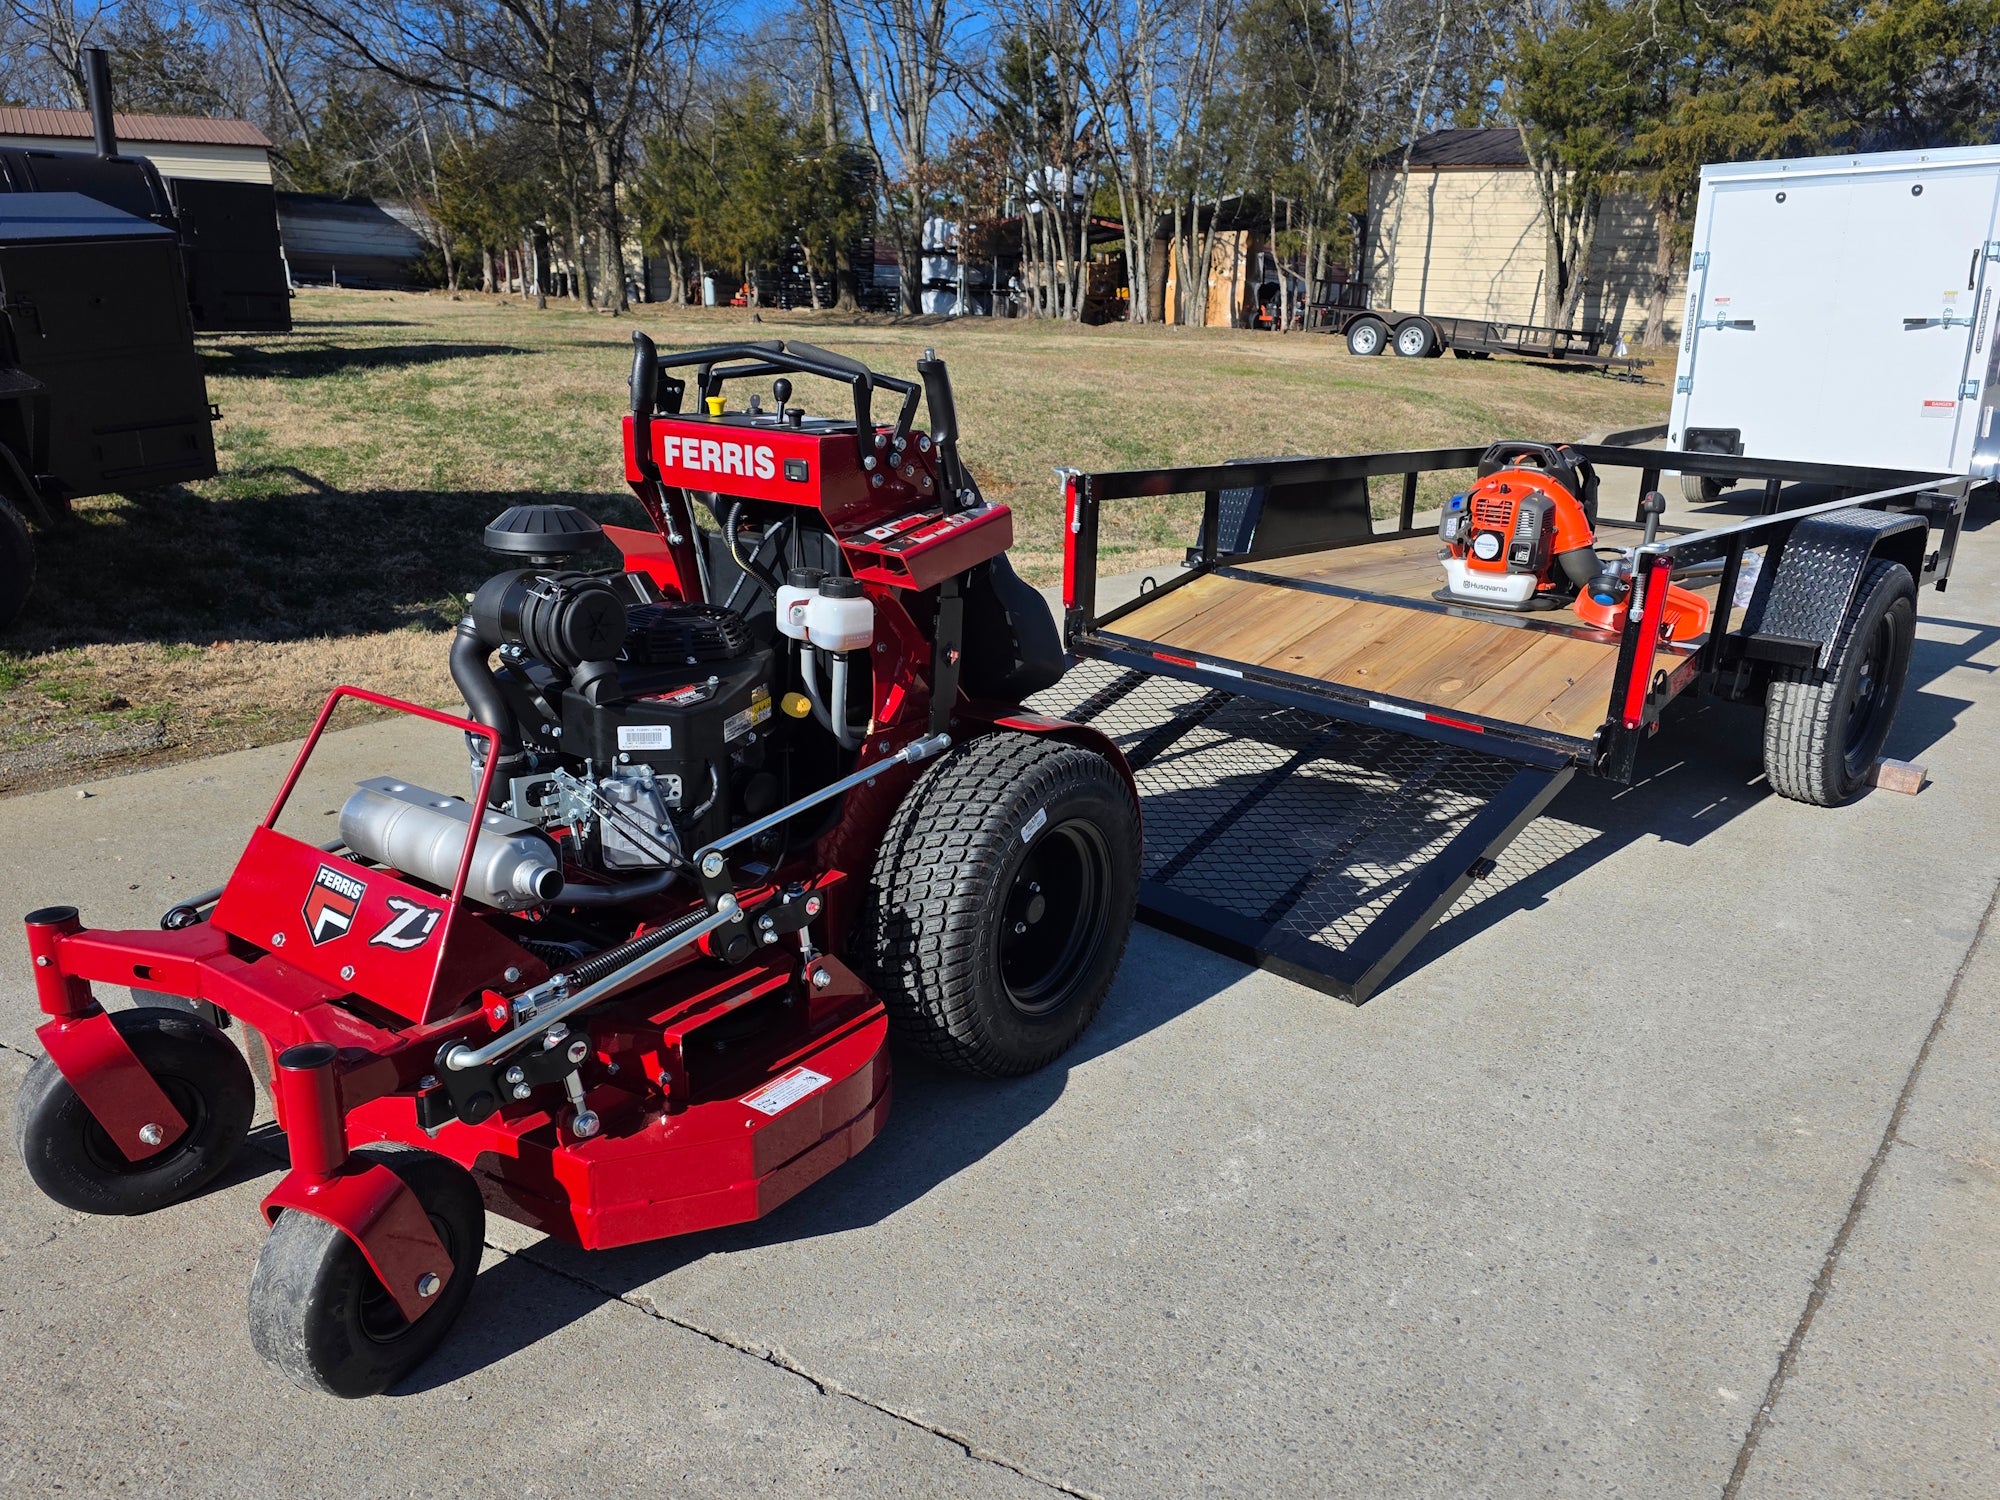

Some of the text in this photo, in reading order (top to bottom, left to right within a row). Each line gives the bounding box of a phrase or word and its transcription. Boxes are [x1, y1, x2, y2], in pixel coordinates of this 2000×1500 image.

[664, 435, 775, 480] FERRIS
[1470, 581, 1508, 594] Husqvarna
[316, 870, 363, 900] FERRIS
[369, 896, 441, 949] Z1
